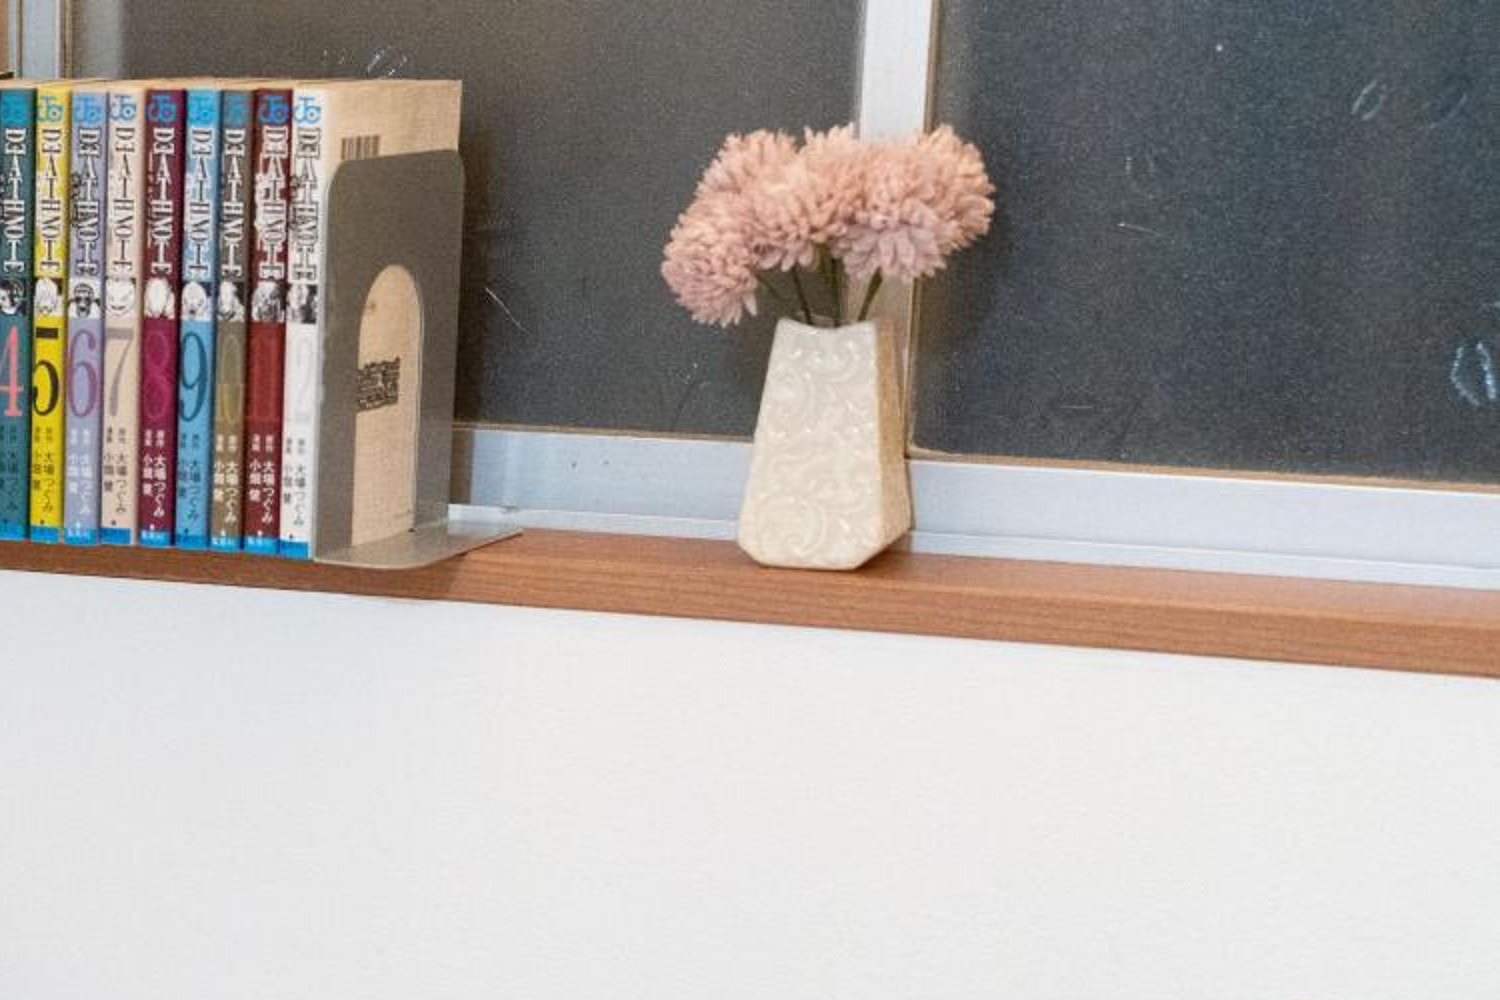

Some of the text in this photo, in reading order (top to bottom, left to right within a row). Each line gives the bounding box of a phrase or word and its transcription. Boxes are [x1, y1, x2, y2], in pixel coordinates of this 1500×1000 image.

[33, 327, 59, 415] 5
[68, 329, 99, 417] 6
[106, 327, 135, 417] 7
[144, 331, 170, 419] 8
[180, 332, 208, 422] 9
